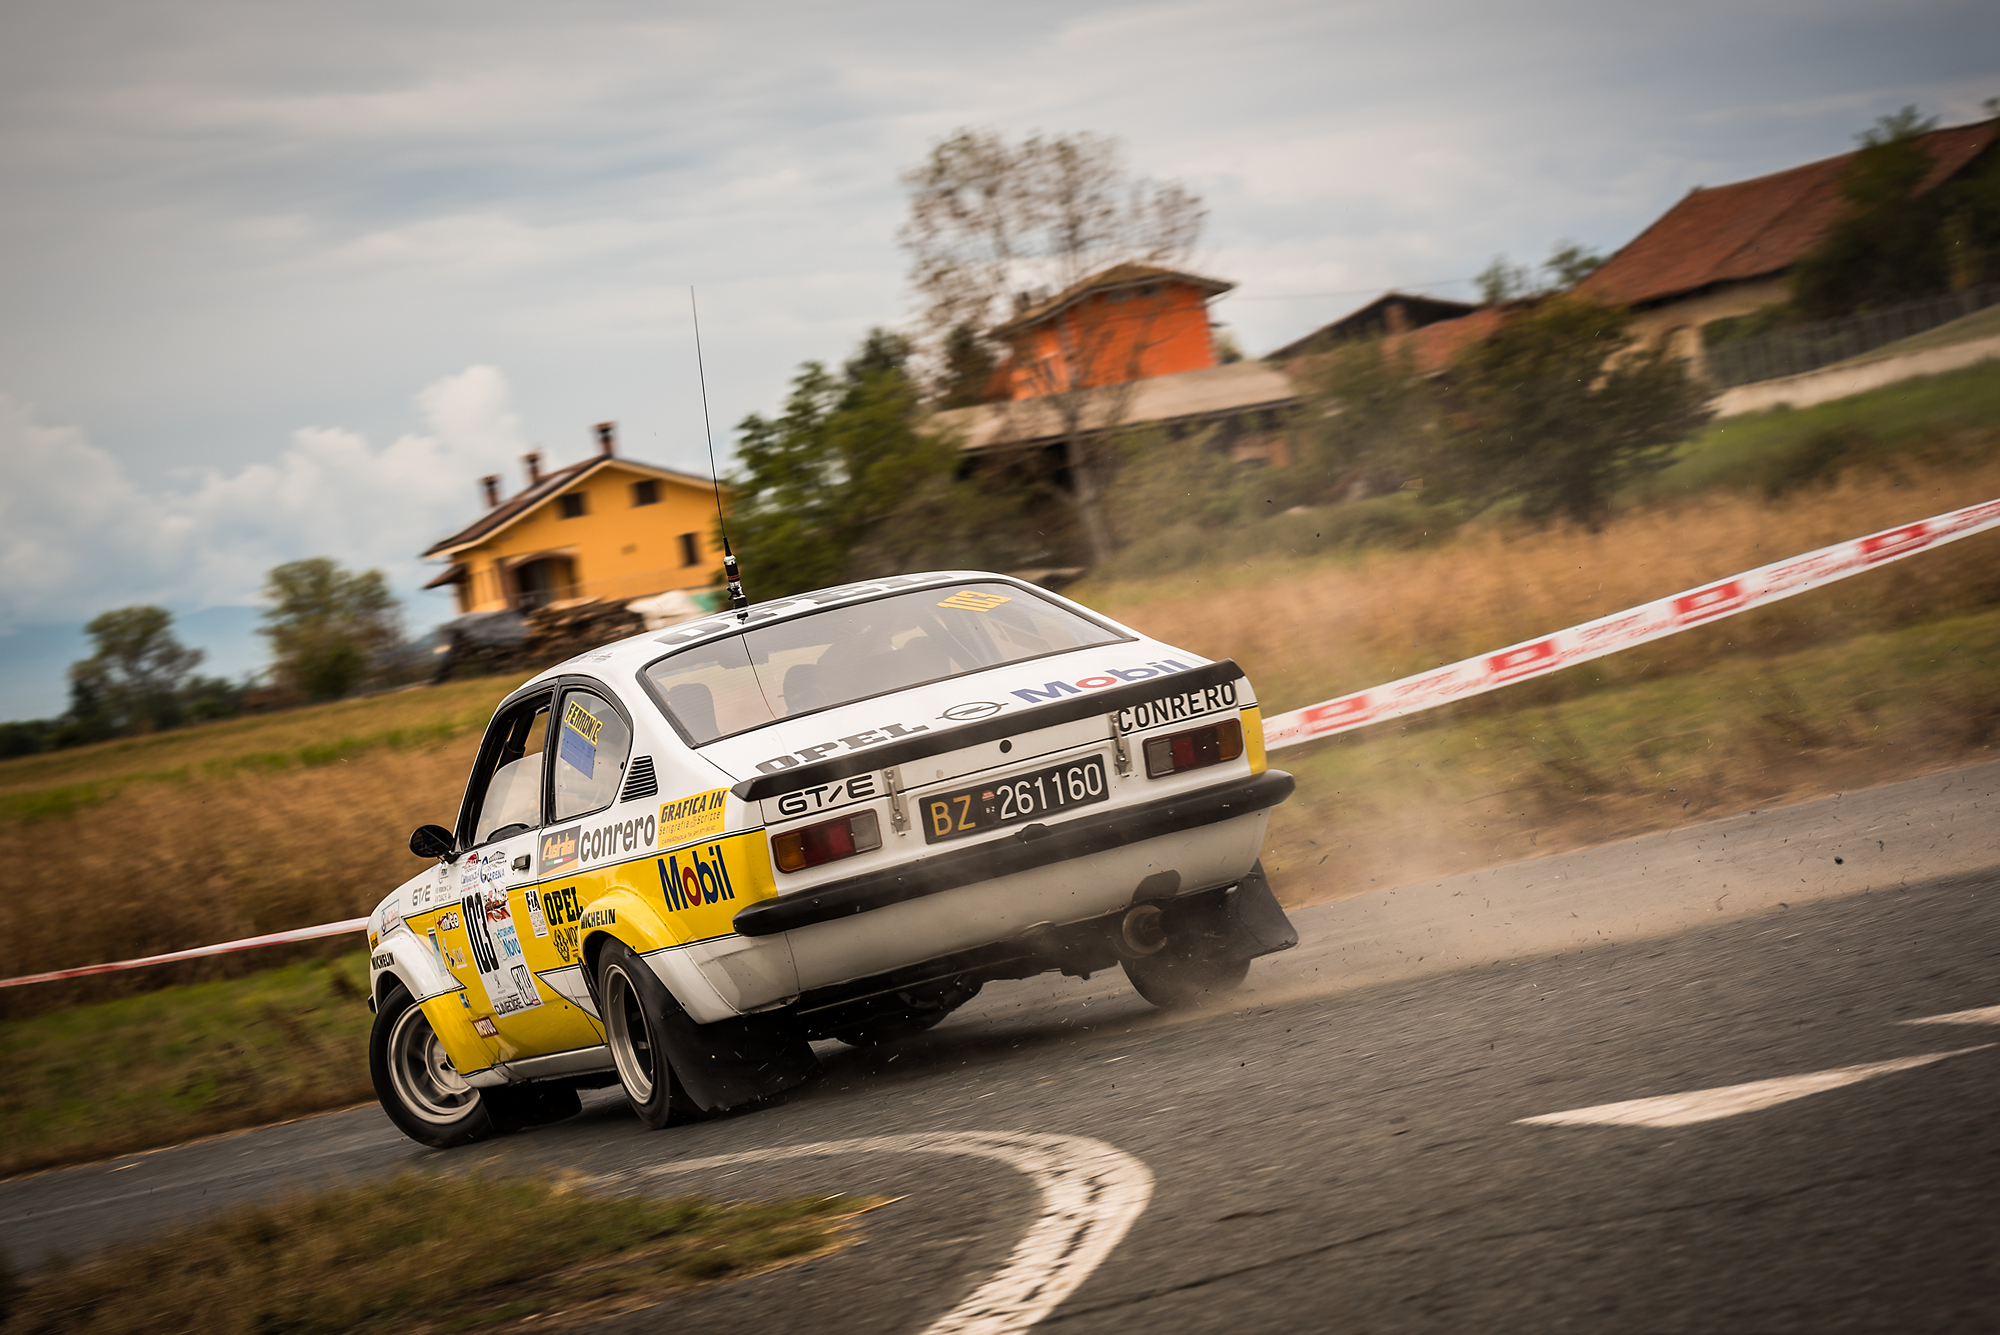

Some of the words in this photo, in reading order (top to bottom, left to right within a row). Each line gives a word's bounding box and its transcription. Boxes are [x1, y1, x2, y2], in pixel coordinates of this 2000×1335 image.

[936, 590, 1012, 613] 103
[1010, 659, 1192, 704] Mobil
[1118, 681, 1238, 733] CONRERO
[755, 723, 930, 774] OPEL
[660, 794, 707, 824] GRAFICA
[708, 789, 728, 811] IN
[778, 775, 875, 815] GT/E
[930, 794, 976, 837] BZ
[996, 763, 1103, 820] 261160
[580, 814, 656, 862] conrero
[657, 844, 736, 913] Mobil
[543, 886, 584, 926] OPEL
[580, 908, 617, 930] MICHELIN
[461, 891, 500, 975] 103
